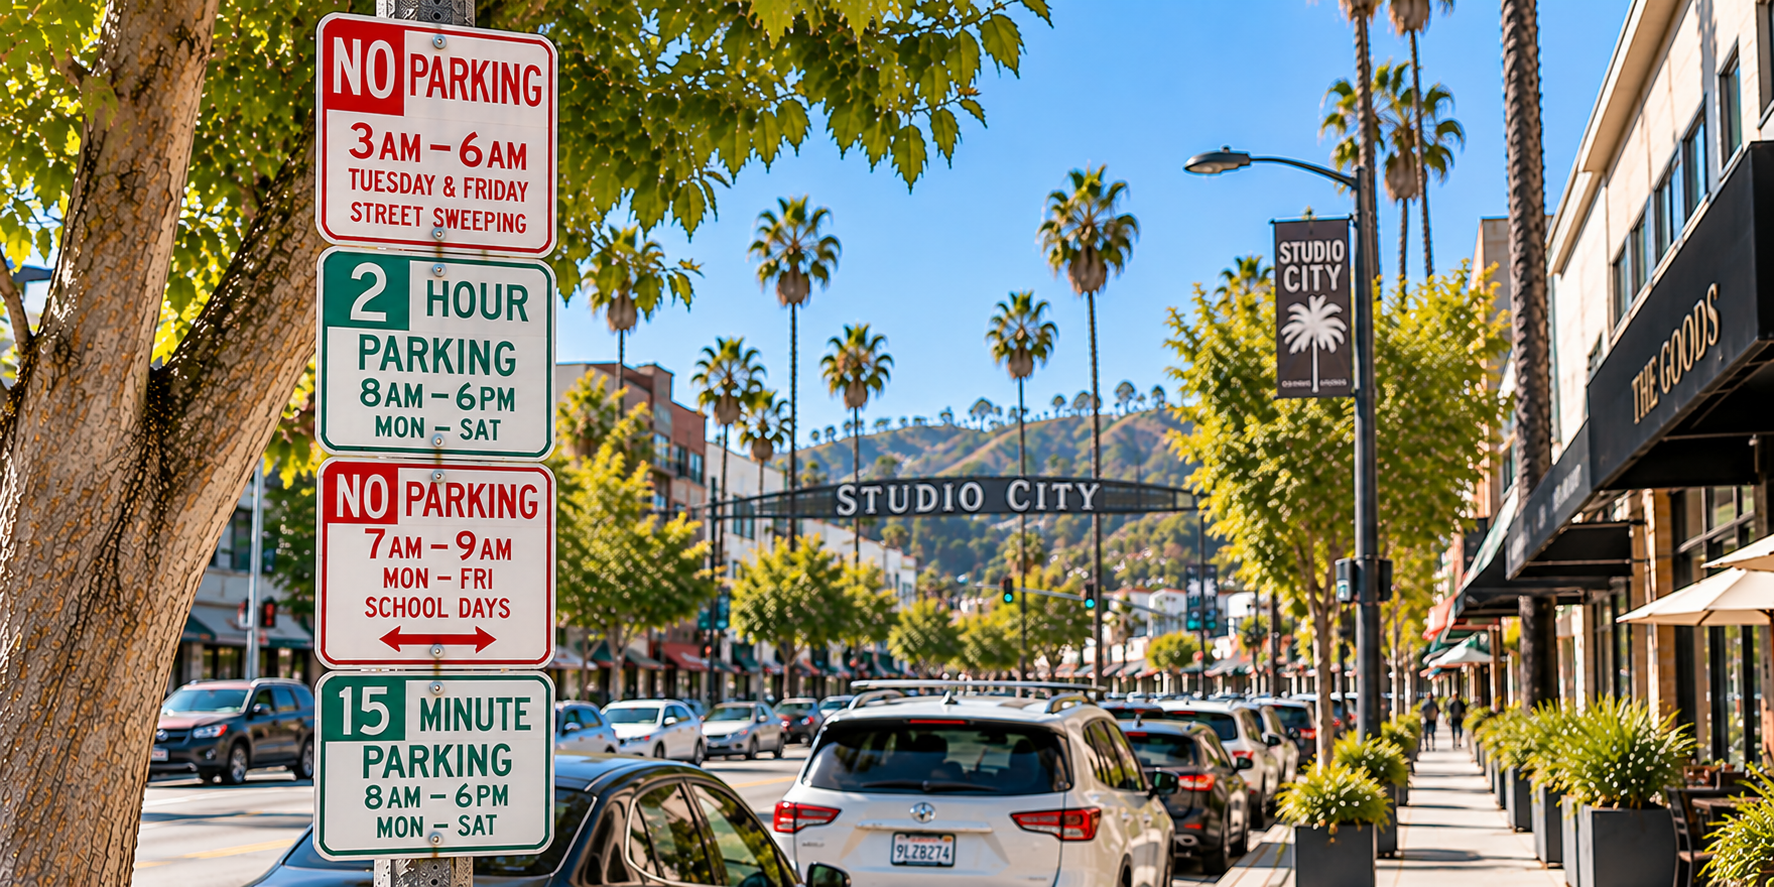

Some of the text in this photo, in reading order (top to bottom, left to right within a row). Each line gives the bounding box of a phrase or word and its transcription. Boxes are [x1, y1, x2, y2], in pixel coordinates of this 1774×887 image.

[333, 37, 542, 108] NO PARKING
[348, 122, 421, 163] 3AM
[459, 131, 527, 171] 6AM
[348, 168, 528, 203] TUESDAY & FRIDAY
[350, 201, 527, 234] STREET SWEEPING
[1279, 239, 1345, 265] STUDIO
[350, 262, 529, 322] 2 HOUR
[1283, 264, 1342, 293] CITY
[359, 334, 516, 377] PARKING
[1631, 283, 1719, 424] THE GOODS
[360, 378, 423, 409] 8AM
[455, 382, 515, 412] 6PM
[375, 416, 424, 438] MON
[460, 418, 501, 441] SAT
[336, 473, 538, 520] NO PARKING
[836, 479, 1100, 516] STUDIO CITY
[365, 528, 421, 559] 7AM
[456, 530, 512, 561] 9AM
[383, 568, 428, 589] MON
[461, 568, 493, 589] FRI
[365, 597, 510, 619] SCHOOL DAYS
[339, 686, 531, 736] 15 MINUTE
[363, 743, 512, 779] PARKING
[365, 785, 421, 809] 8AM
[455, 783, 508, 807] 6PM
[376, 816, 423, 838] MON
[457, 815, 497, 836] SAT
